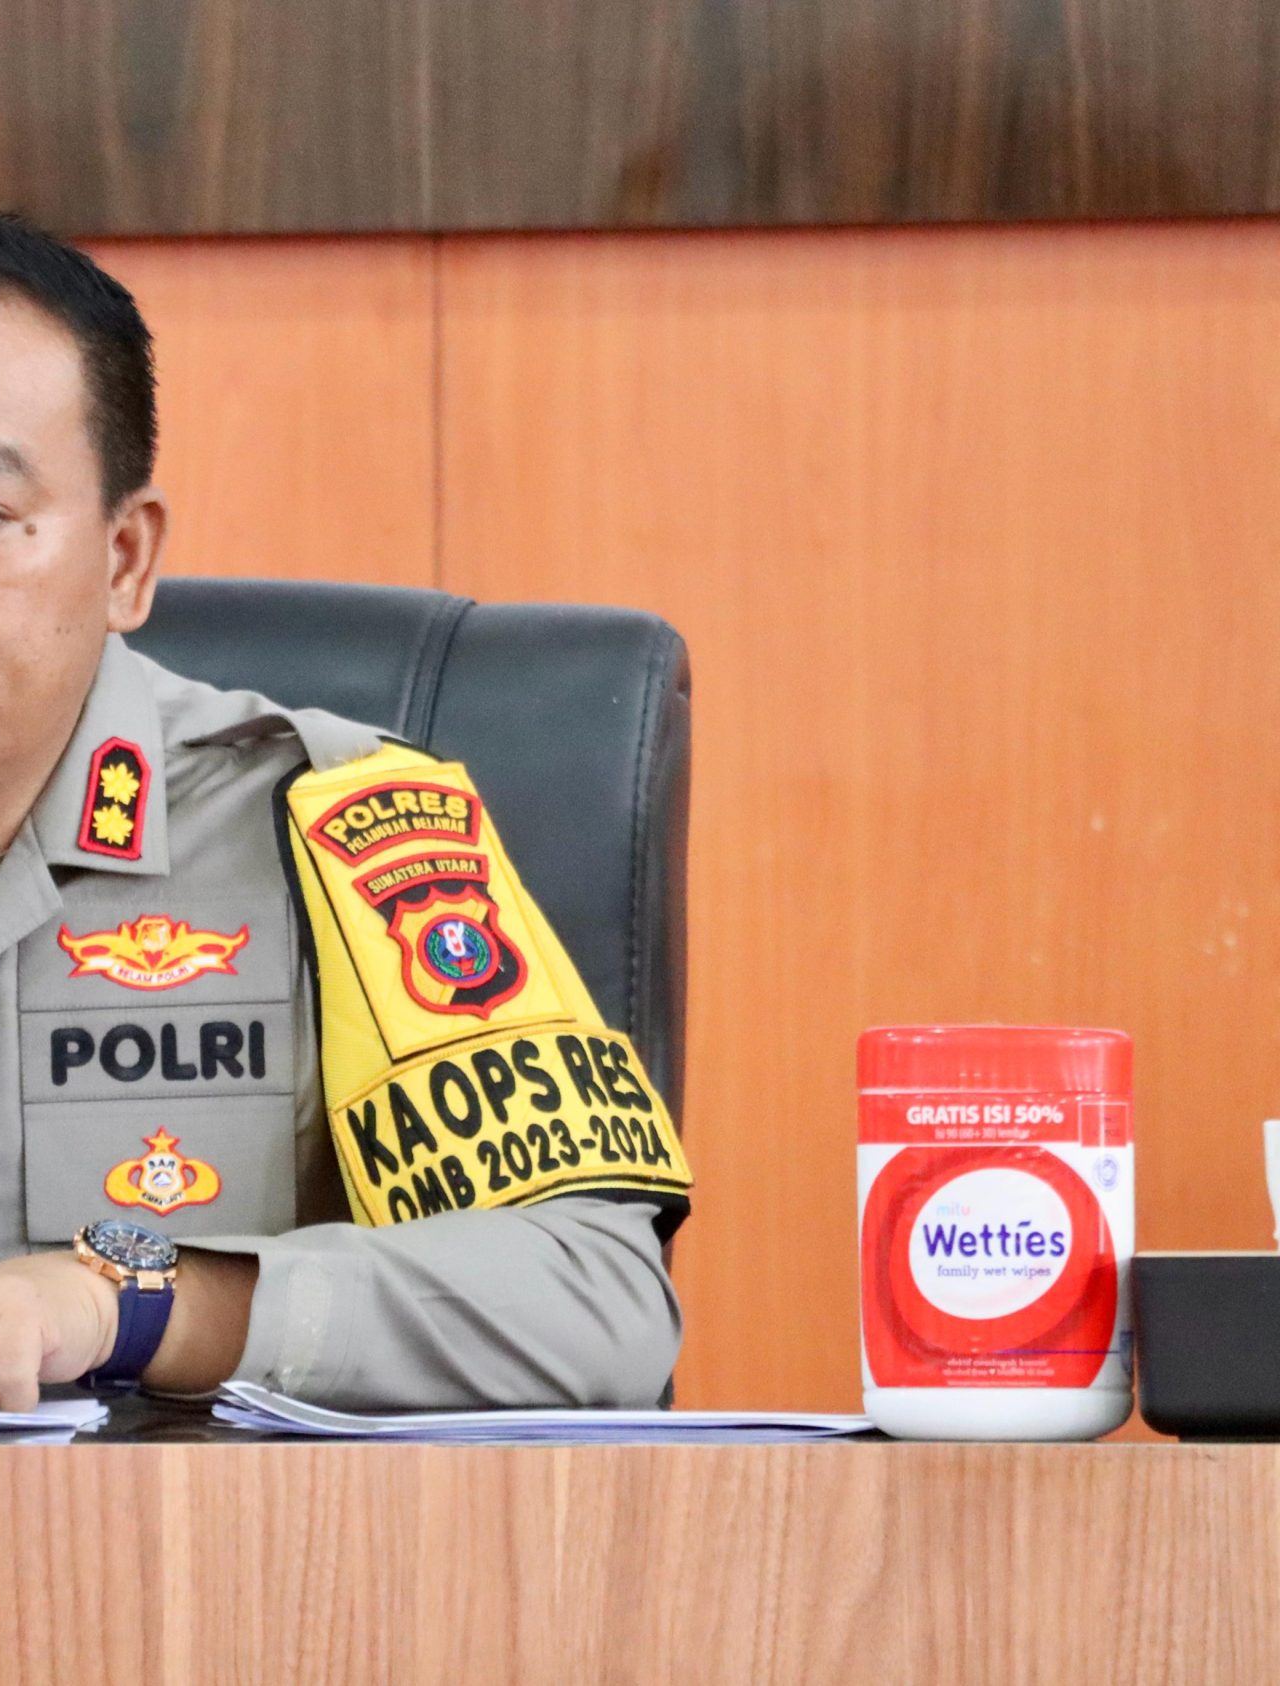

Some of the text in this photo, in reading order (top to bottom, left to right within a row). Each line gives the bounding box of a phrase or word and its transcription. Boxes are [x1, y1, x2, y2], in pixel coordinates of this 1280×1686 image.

[323, 791, 468, 843] POLRES
[346, 817, 466, 855] PELABUHAN BELAWAN
[367, 859, 478, 894] SUMATERA UTARA
[51, 1021, 266, 1086] POLRI
[556, 1034, 652, 1113] RES
[906, 1105, 1064, 1125] GRATIS ISI 50%
[388, 1115, 671, 1224] OMB 2023-2024
[923, 1219, 1065, 1257] Wetties
[937, 1265, 1052, 1280] family wet wipes
